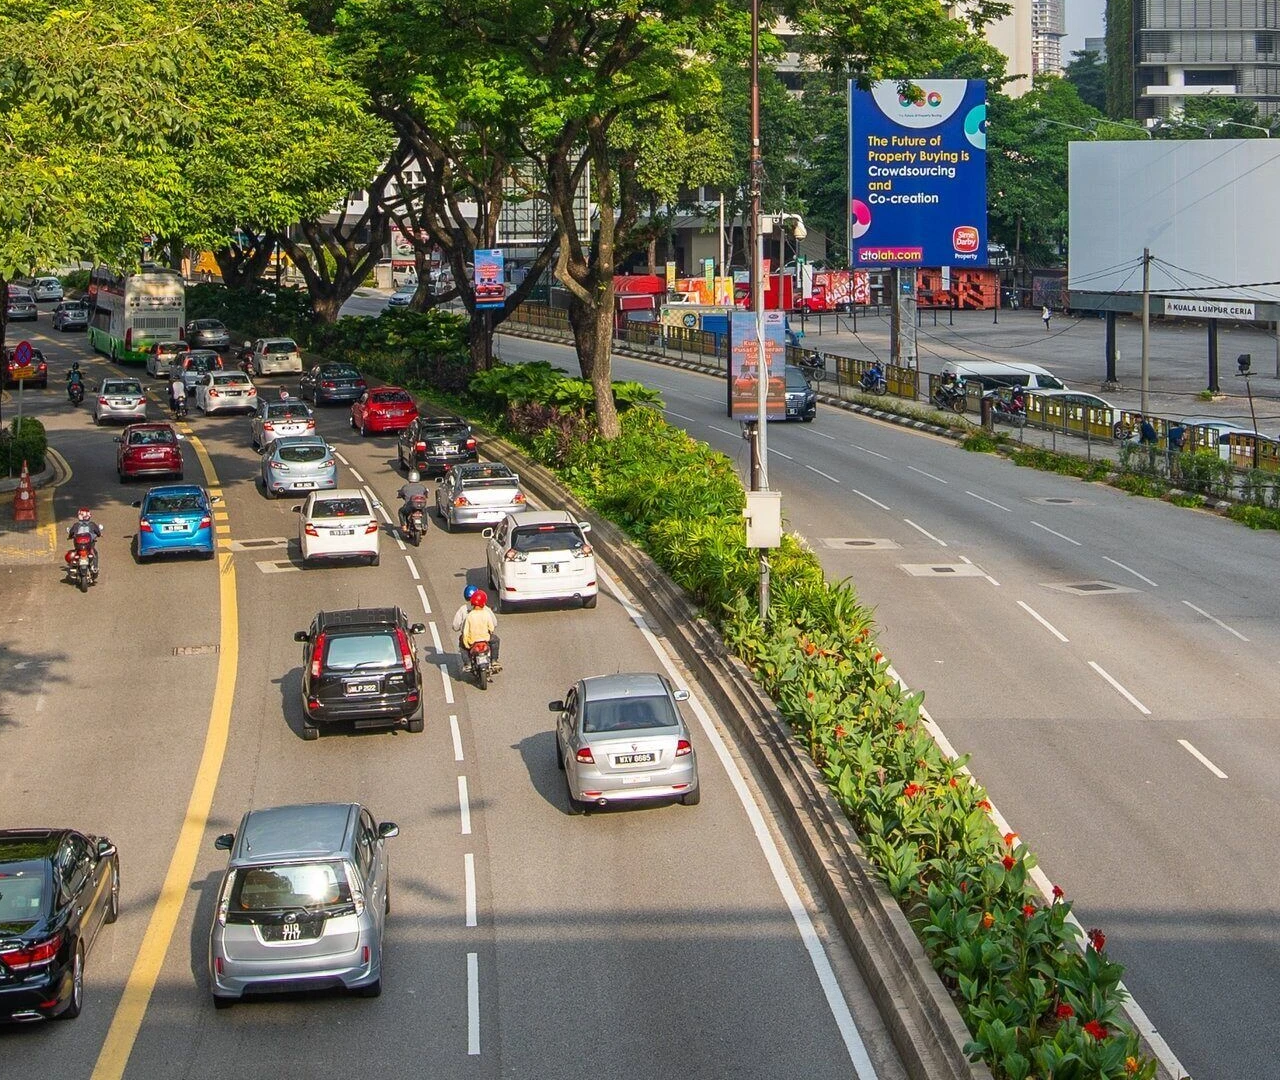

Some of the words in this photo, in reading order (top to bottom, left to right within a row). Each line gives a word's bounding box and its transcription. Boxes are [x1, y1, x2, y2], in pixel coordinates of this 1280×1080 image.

[868, 136, 888, 146] The
[891, 136, 927, 146] Future
[929, 135, 942, 146] of
[868, 151, 916, 163] Property
[920, 151, 958, 163] Buying
[961, 151, 970, 161] is
[868, 165, 956, 178] Crowdsourcing
[868, 180, 892, 191] and
[868, 193, 939, 204] Co-creation
[957, 231, 975, 239] Sime
[956, 237, 977, 247] Darby
[860, 251, 921, 261] dtolah.com
[1173, 304, 1197, 312] KUALA
[1198, 305, 1228, 314] LUMPUR
[1230, 307, 1253, 315] CERIA
